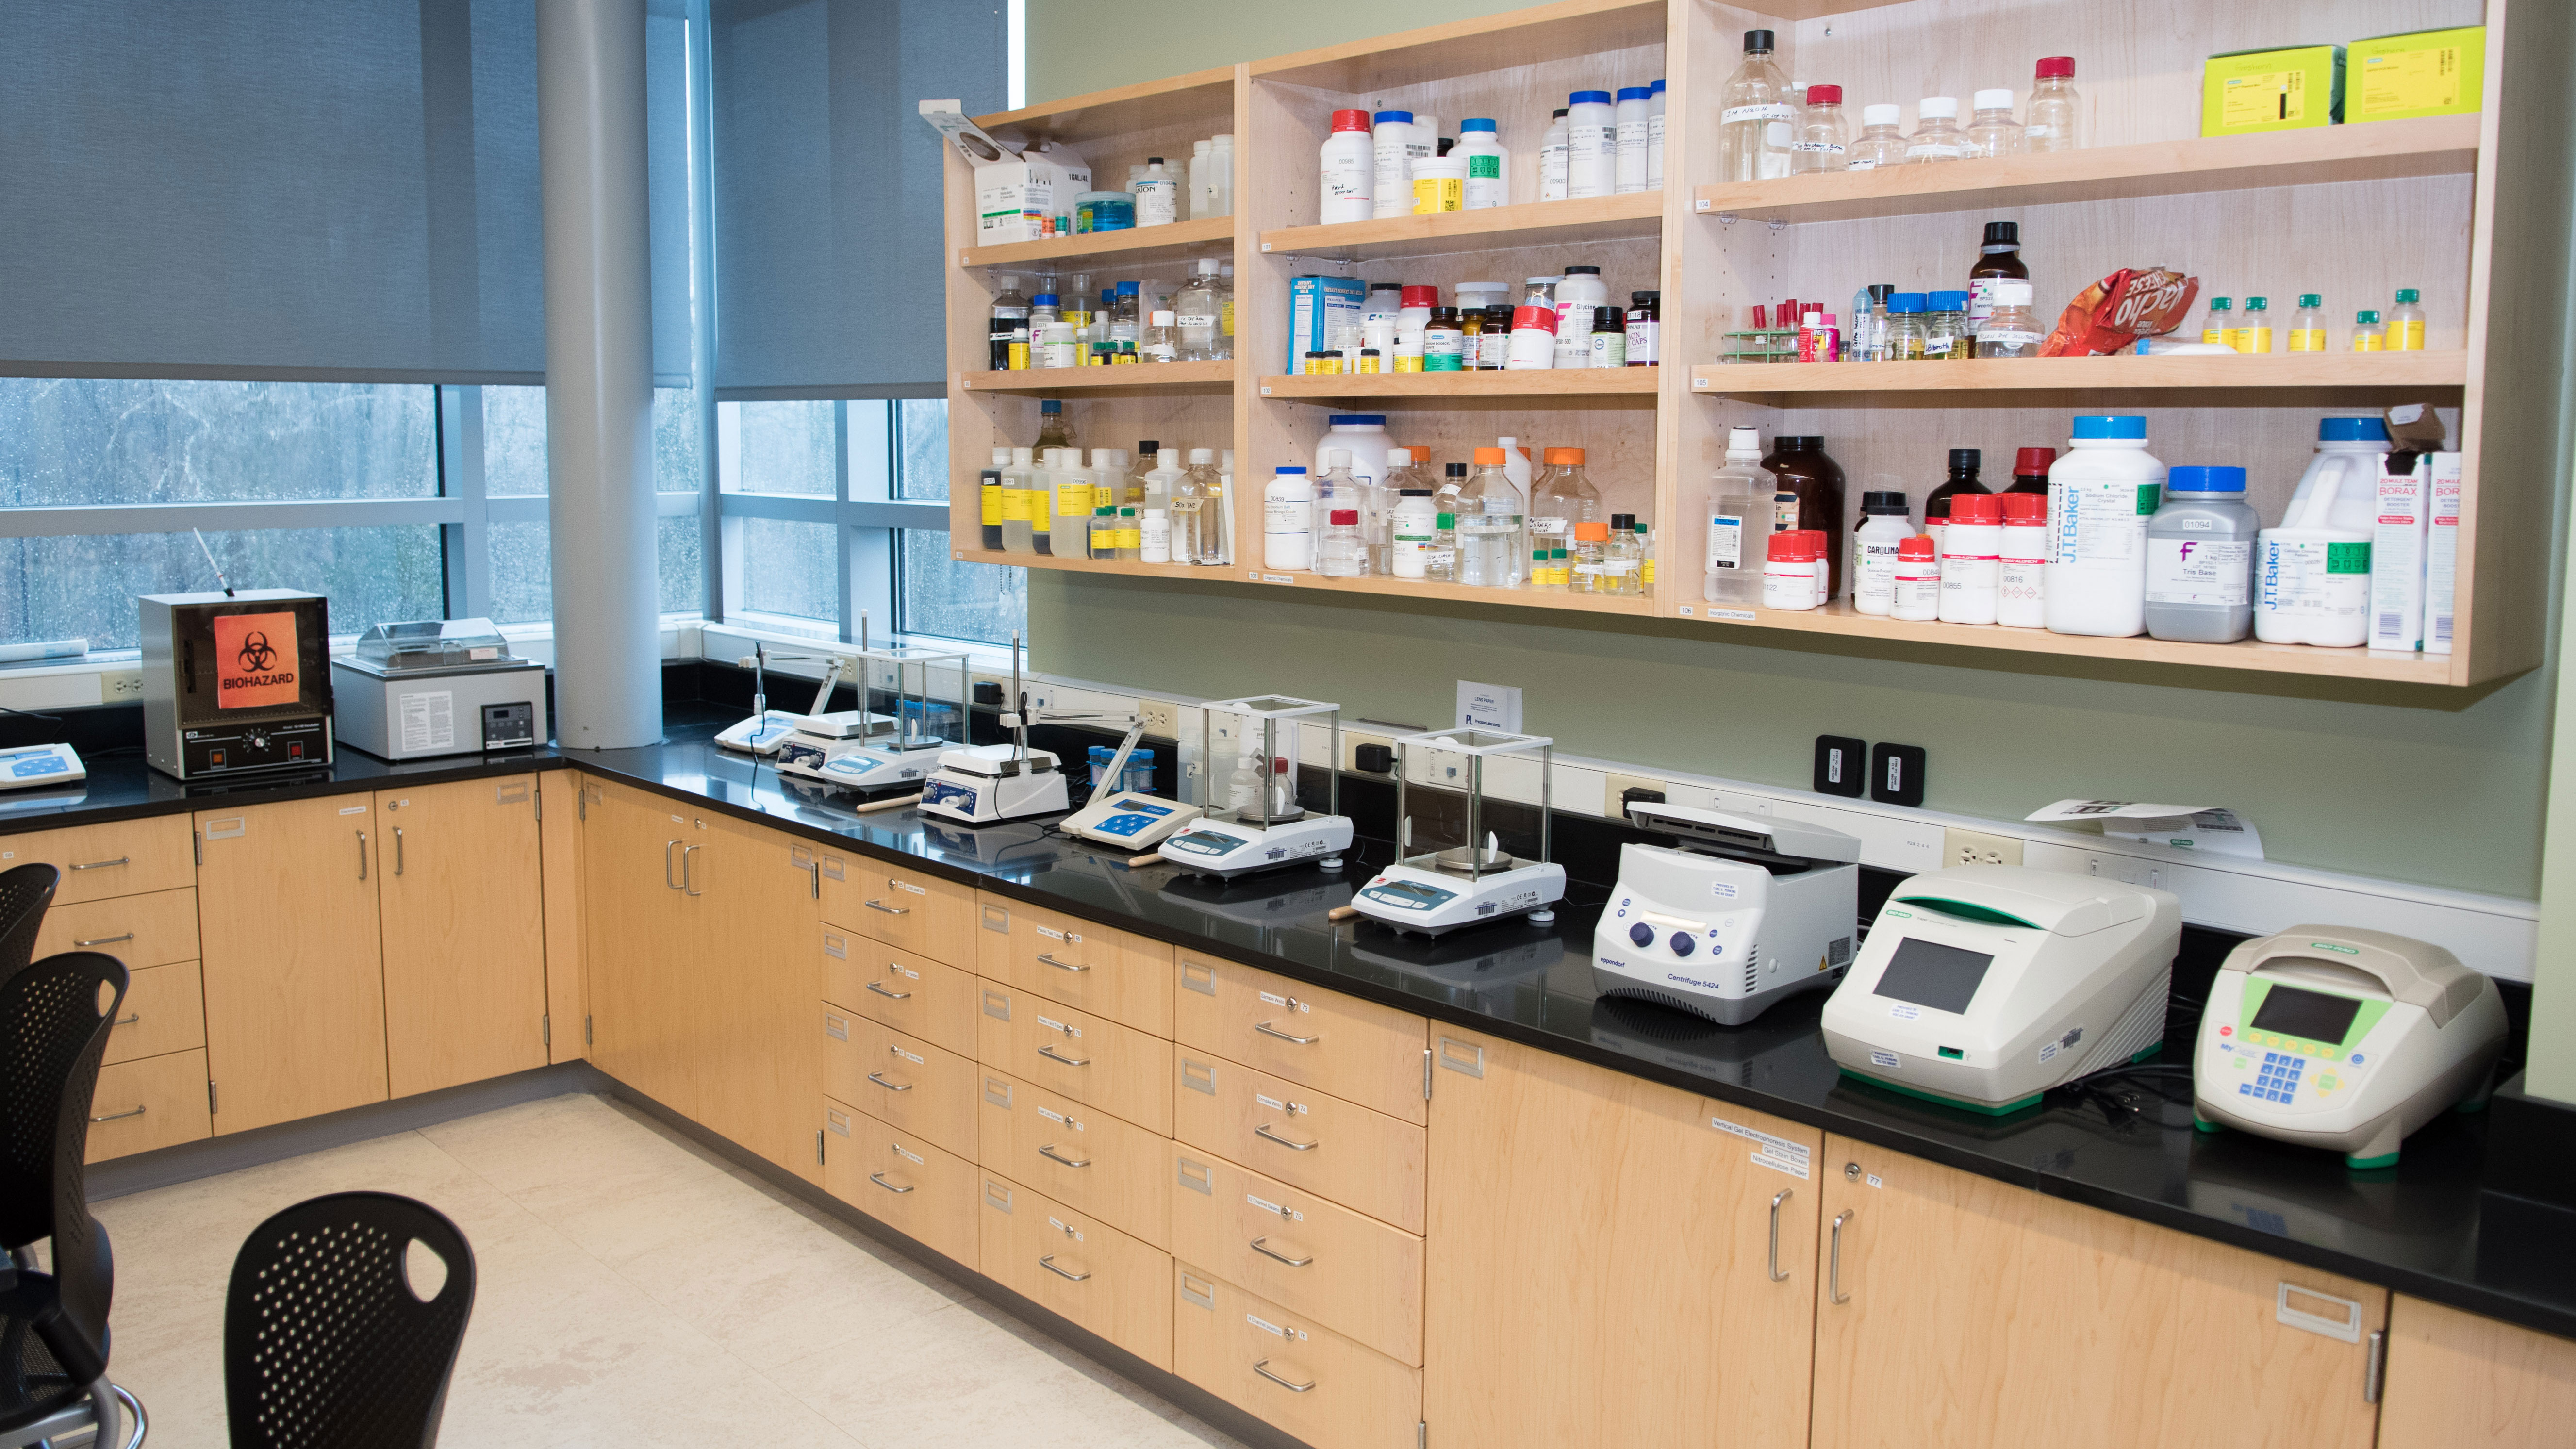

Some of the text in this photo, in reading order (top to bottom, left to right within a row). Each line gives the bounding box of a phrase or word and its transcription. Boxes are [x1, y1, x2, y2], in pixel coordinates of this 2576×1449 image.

[2125, 270, 2169, 297] CHEESE
[2114, 278, 2188, 327] Nacho
[1632, 337, 1647, 346] CAPS
[2379, 487, 2417, 496] BORAX
[2436, 487, 2460, 496] BOR
[2061, 486, 2080, 563] J.T.Baker
[1867, 546, 1899, 555] CAROLINA
[2003, 575, 2023, 583] 00816
[2264, 540, 2279, 610] J.T.Baker
[223, 673, 294, 690] BIOHAZARD
[1038, 926, 1048, 934] Plastic
[1054, 931, 1063, 939] Tubes
[2314, 943, 2357, 954] BIO-RAD
[1600, 957, 1625, 968] eppendorf
[1668, 973, 1719, 990] Centrifuge 5424
[1261, 993, 1274, 1002] Sample
[1038, 1016, 1048, 1025] Plastic
[1054, 1022, 1063, 1031] Tubes
[1258, 1095, 1282, 1108] Sample Wells
[1713, 1120, 1809, 1155] Vertical Gel Electrophoresis System
[1764, 1146, 1808, 1166] Gel Stain Boxes
[1752, 1154, 1808, 1178] Nitrocellulose Paper
[1869, 1176, 1880, 1185] 77
[1253, 1198, 1268, 1208] Channel
[1268, 1203, 1280, 1213] Basins
[1050, 1218, 1063, 1229] Columns
[1252, 1317, 1266, 1328] Channel
